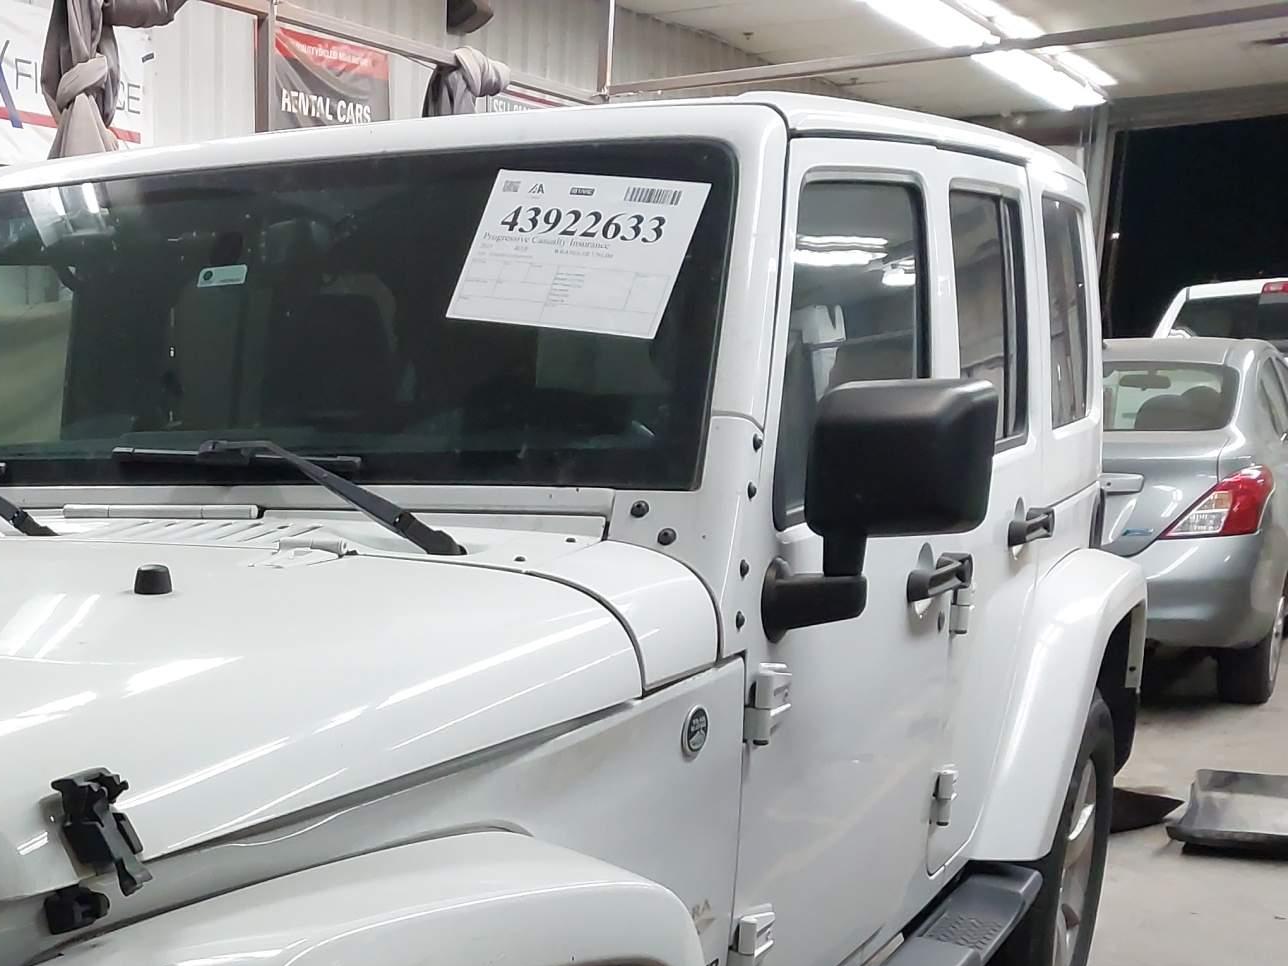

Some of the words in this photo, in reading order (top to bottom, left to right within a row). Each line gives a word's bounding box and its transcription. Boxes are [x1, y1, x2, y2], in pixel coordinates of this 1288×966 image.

[281, 88, 333, 121] RENTAL
[336, 100, 372, 124] CARS
[483, 231, 530, 243] Progressive
[532, 236, 566, 247] Casualty
[569, 238, 611, 250] Insurance
[500, 205, 666, 243] 43922633
